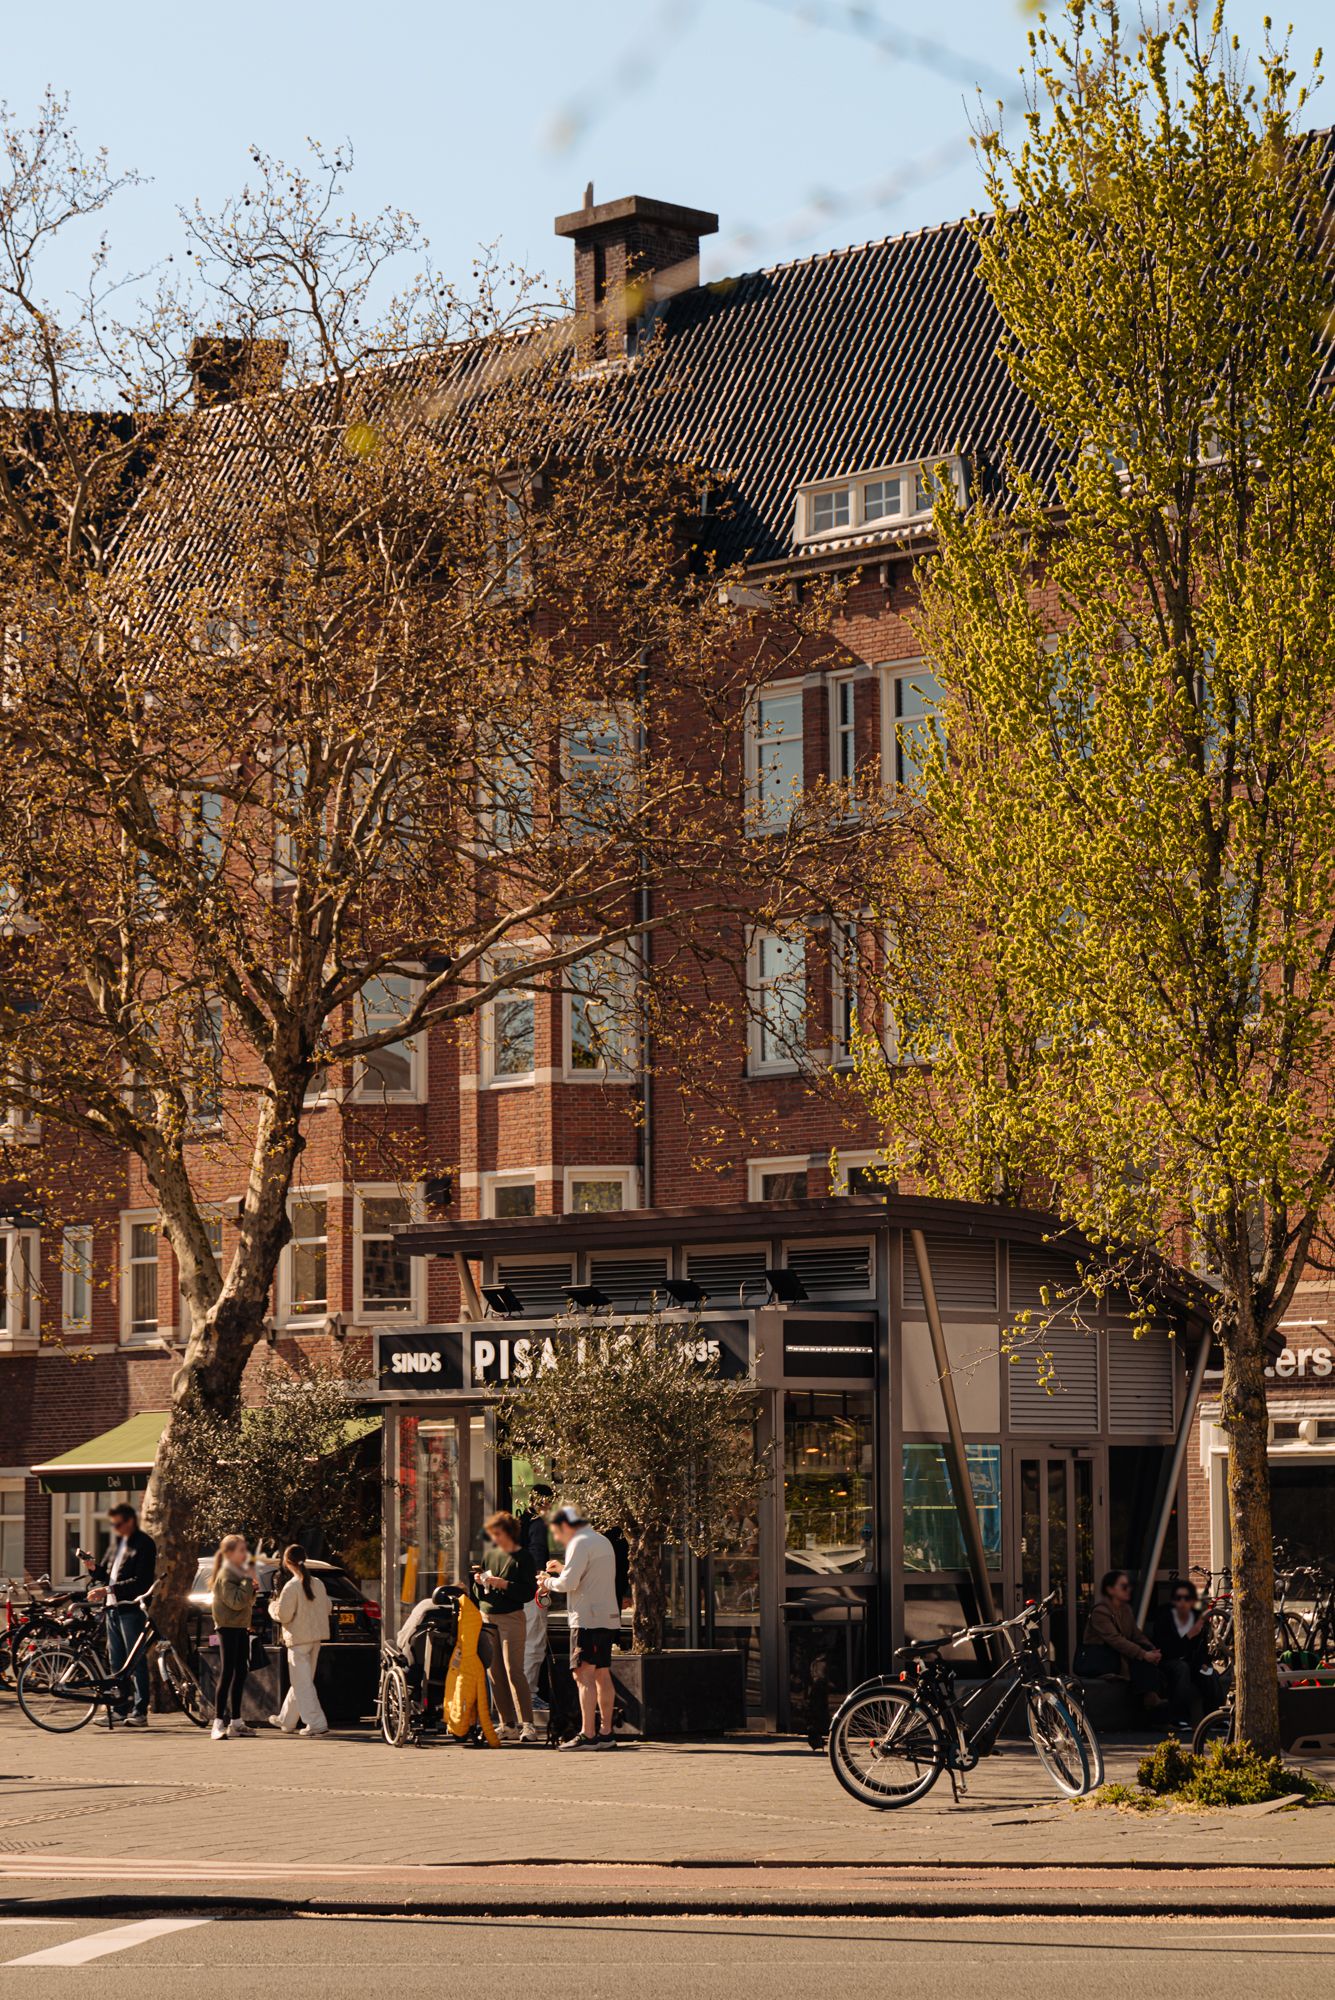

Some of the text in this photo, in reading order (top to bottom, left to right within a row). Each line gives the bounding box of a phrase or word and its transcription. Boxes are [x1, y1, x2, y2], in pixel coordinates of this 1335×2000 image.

[391, 1351, 442, 1373] SINDS
[474, 1336, 560, 1380] PISA
[1264, 1347, 1333, 1378] ers
